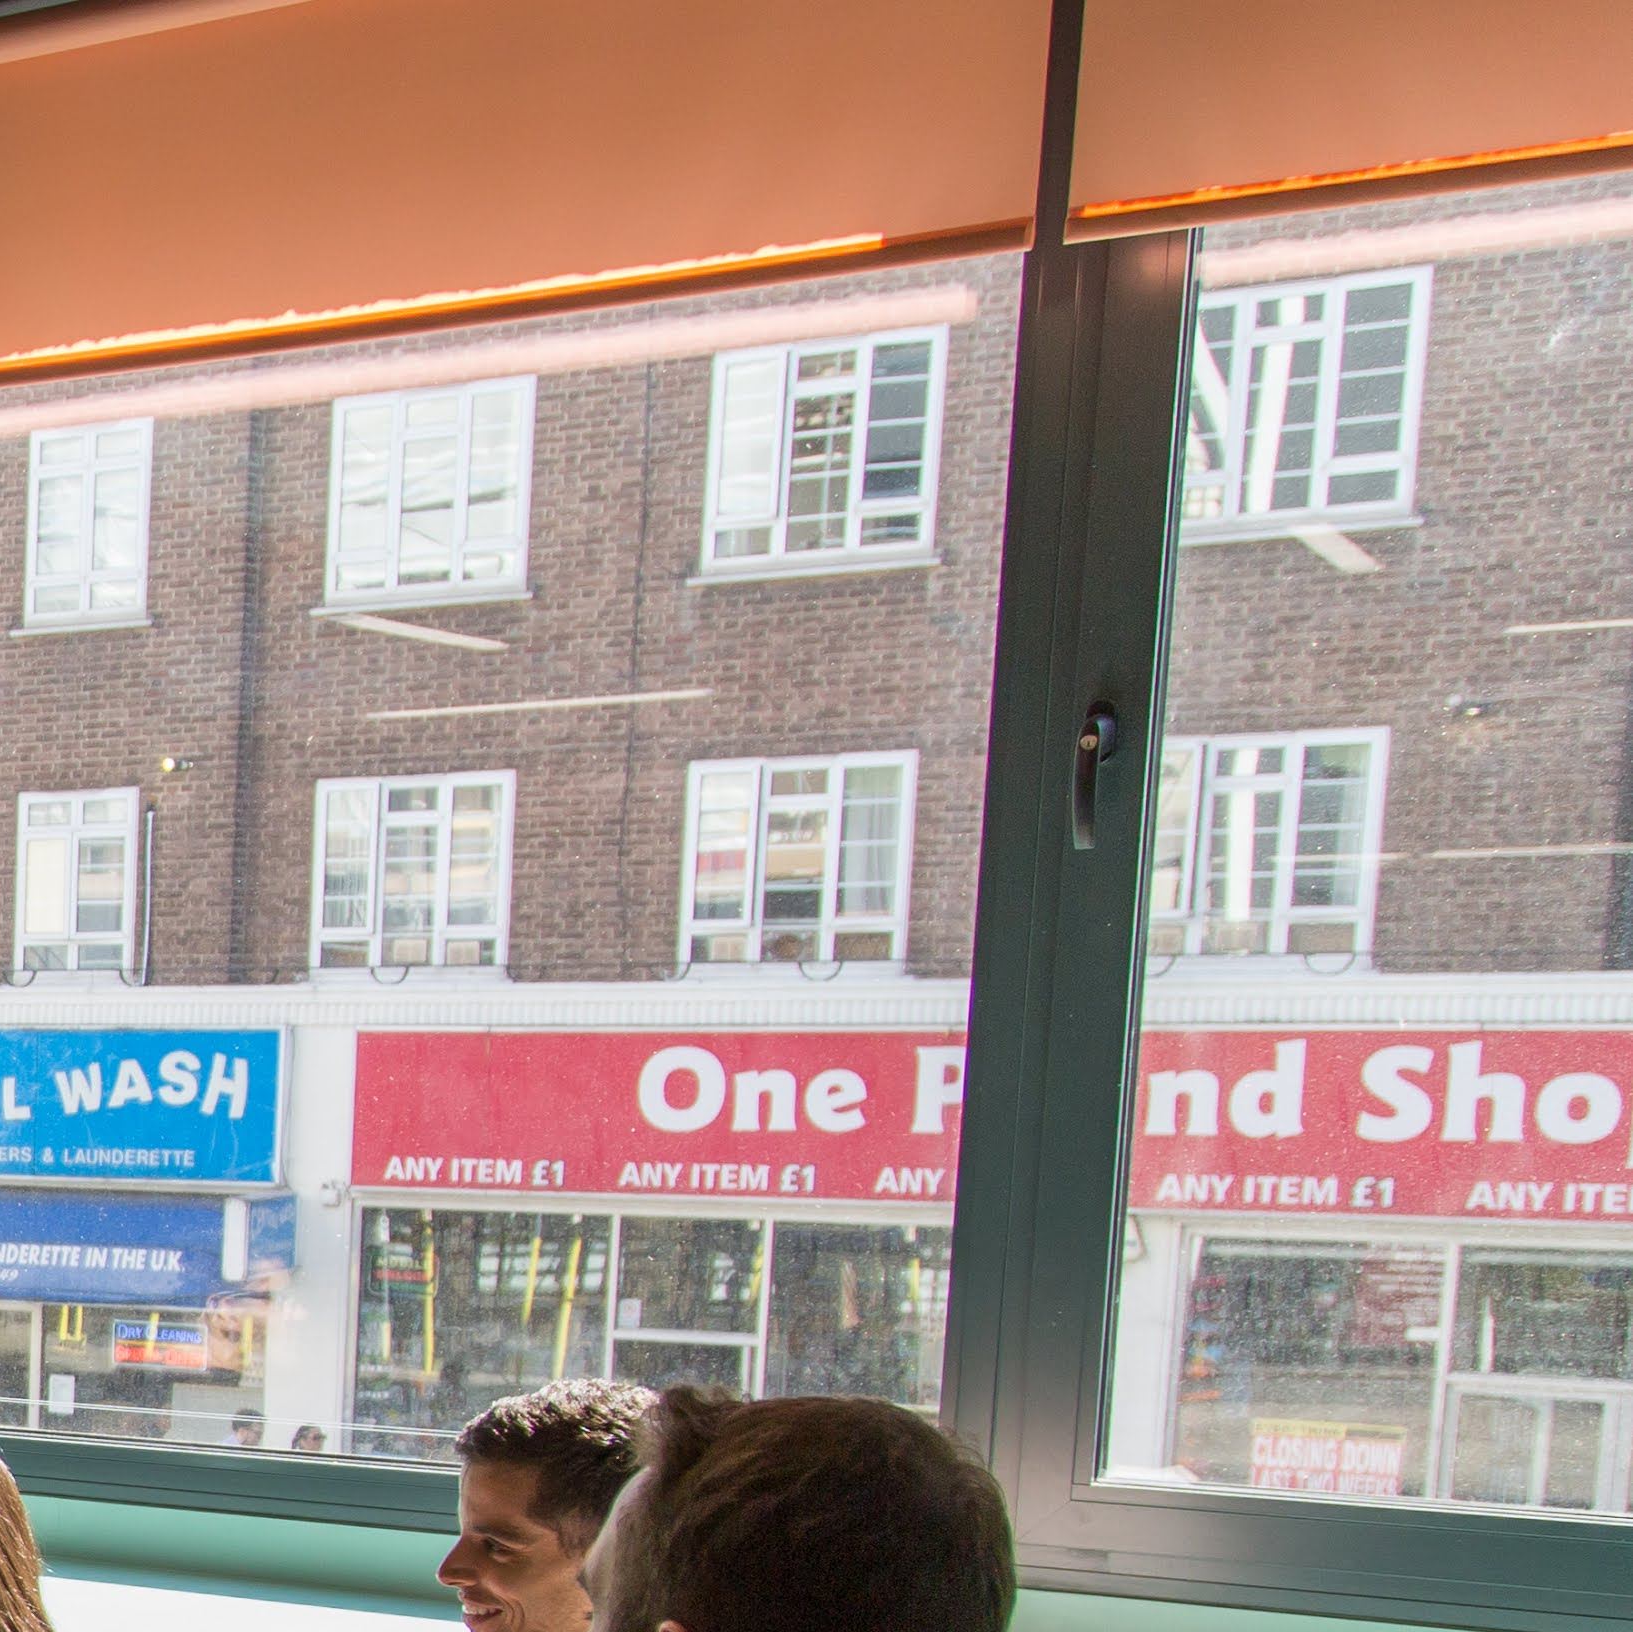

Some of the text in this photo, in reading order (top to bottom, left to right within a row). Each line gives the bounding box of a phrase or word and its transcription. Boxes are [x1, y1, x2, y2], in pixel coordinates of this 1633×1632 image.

[54, 1049, 249, 1120] WASH
[638, 1045, 868, 1134] One
[1356, 1038, 1633, 1170] Sho
[42, 1146, 55, 1164] &
[63, 1148, 196, 1169] LAUNDERETTE
[384, 1156, 566, 1188] ANY ITEM £1
[618, 1161, 816, 1193] ANY ITEM £1
[873, 1166, 946, 1194] ANY
[1156, 1173, 1396, 1208] ANY ITEM £1
[1464, 1180, 1633, 1214] ANY ITE
[85, 1247, 107, 1269] IN
[111, 1248, 146, 1271] THE
[150, 1250, 186, 1273] U.K.
[1253, 1434, 1402, 1474] CLOSING DOWN
